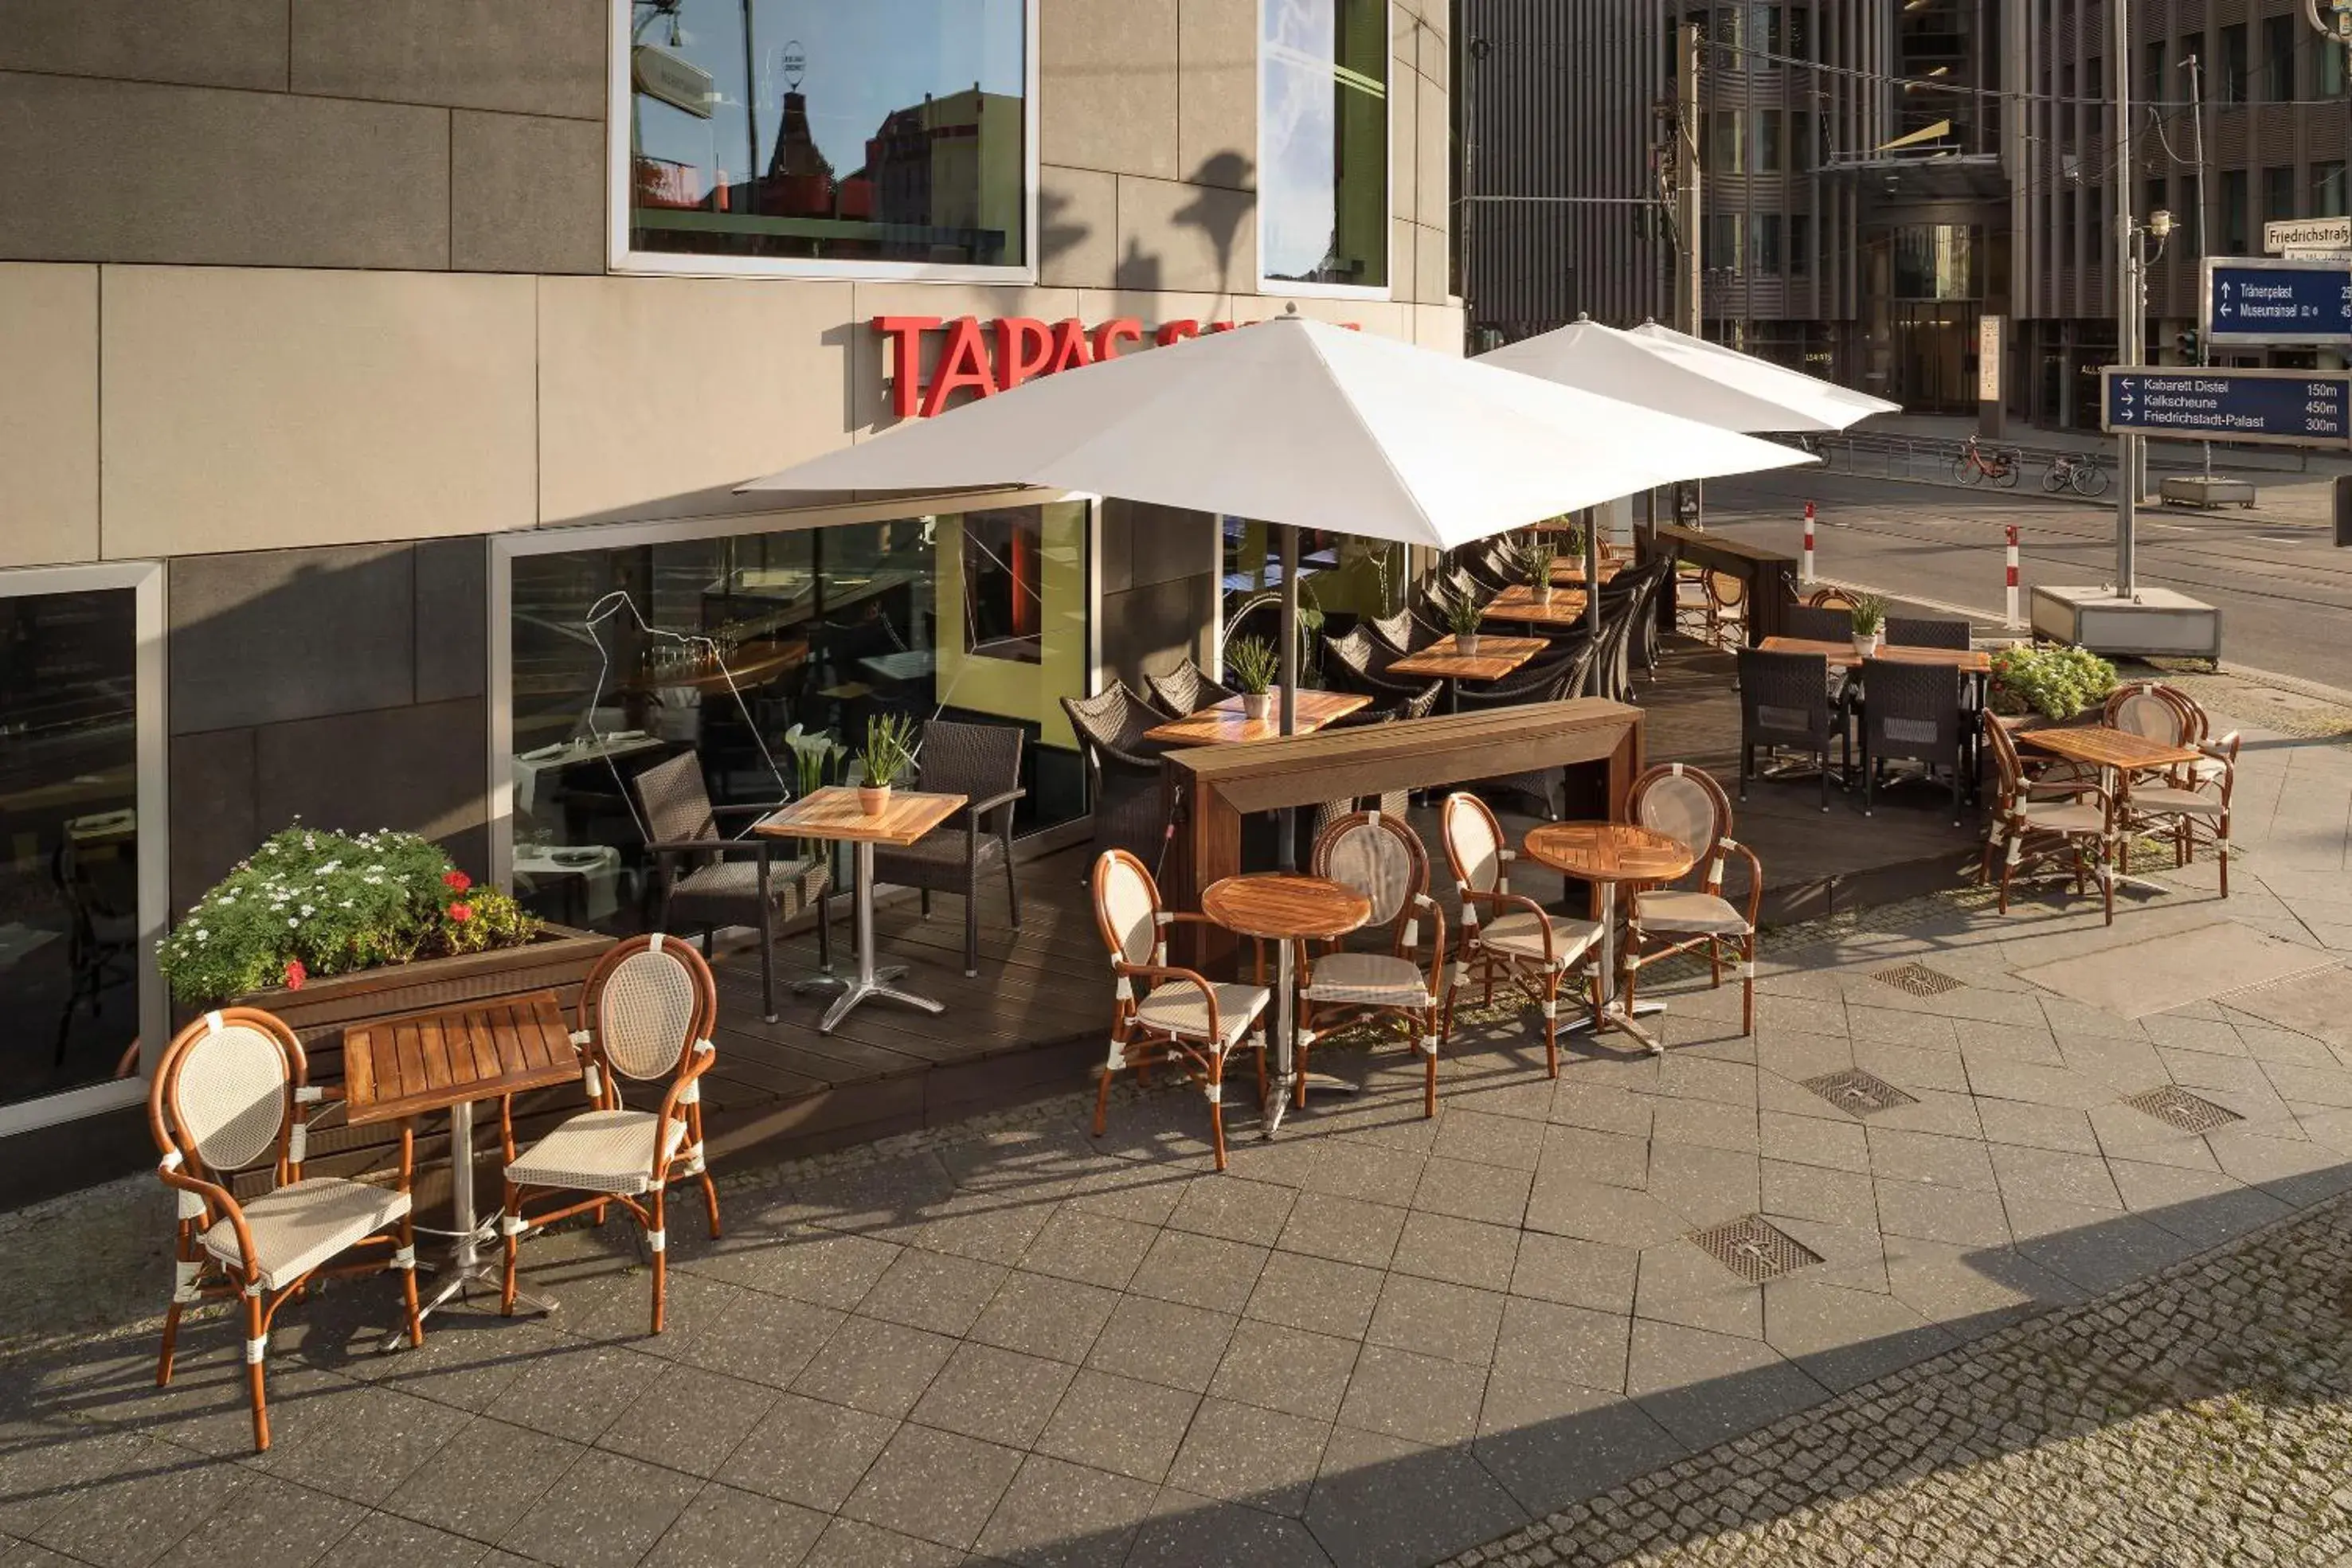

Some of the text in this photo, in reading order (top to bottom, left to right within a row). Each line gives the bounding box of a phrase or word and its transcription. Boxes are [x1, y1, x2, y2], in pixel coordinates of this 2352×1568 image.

[2240, 283, 2292, 300] Tränenpalast
[2240, 303, 2298, 318] Museumsinsel
[2144, 379, 2337, 397] Kabarett Distel 150m
[2144, 394, 2337, 415] Kalkscheune 450m
[2144, 410, 2337, 432] Friedrichstadt-Palast 300m
